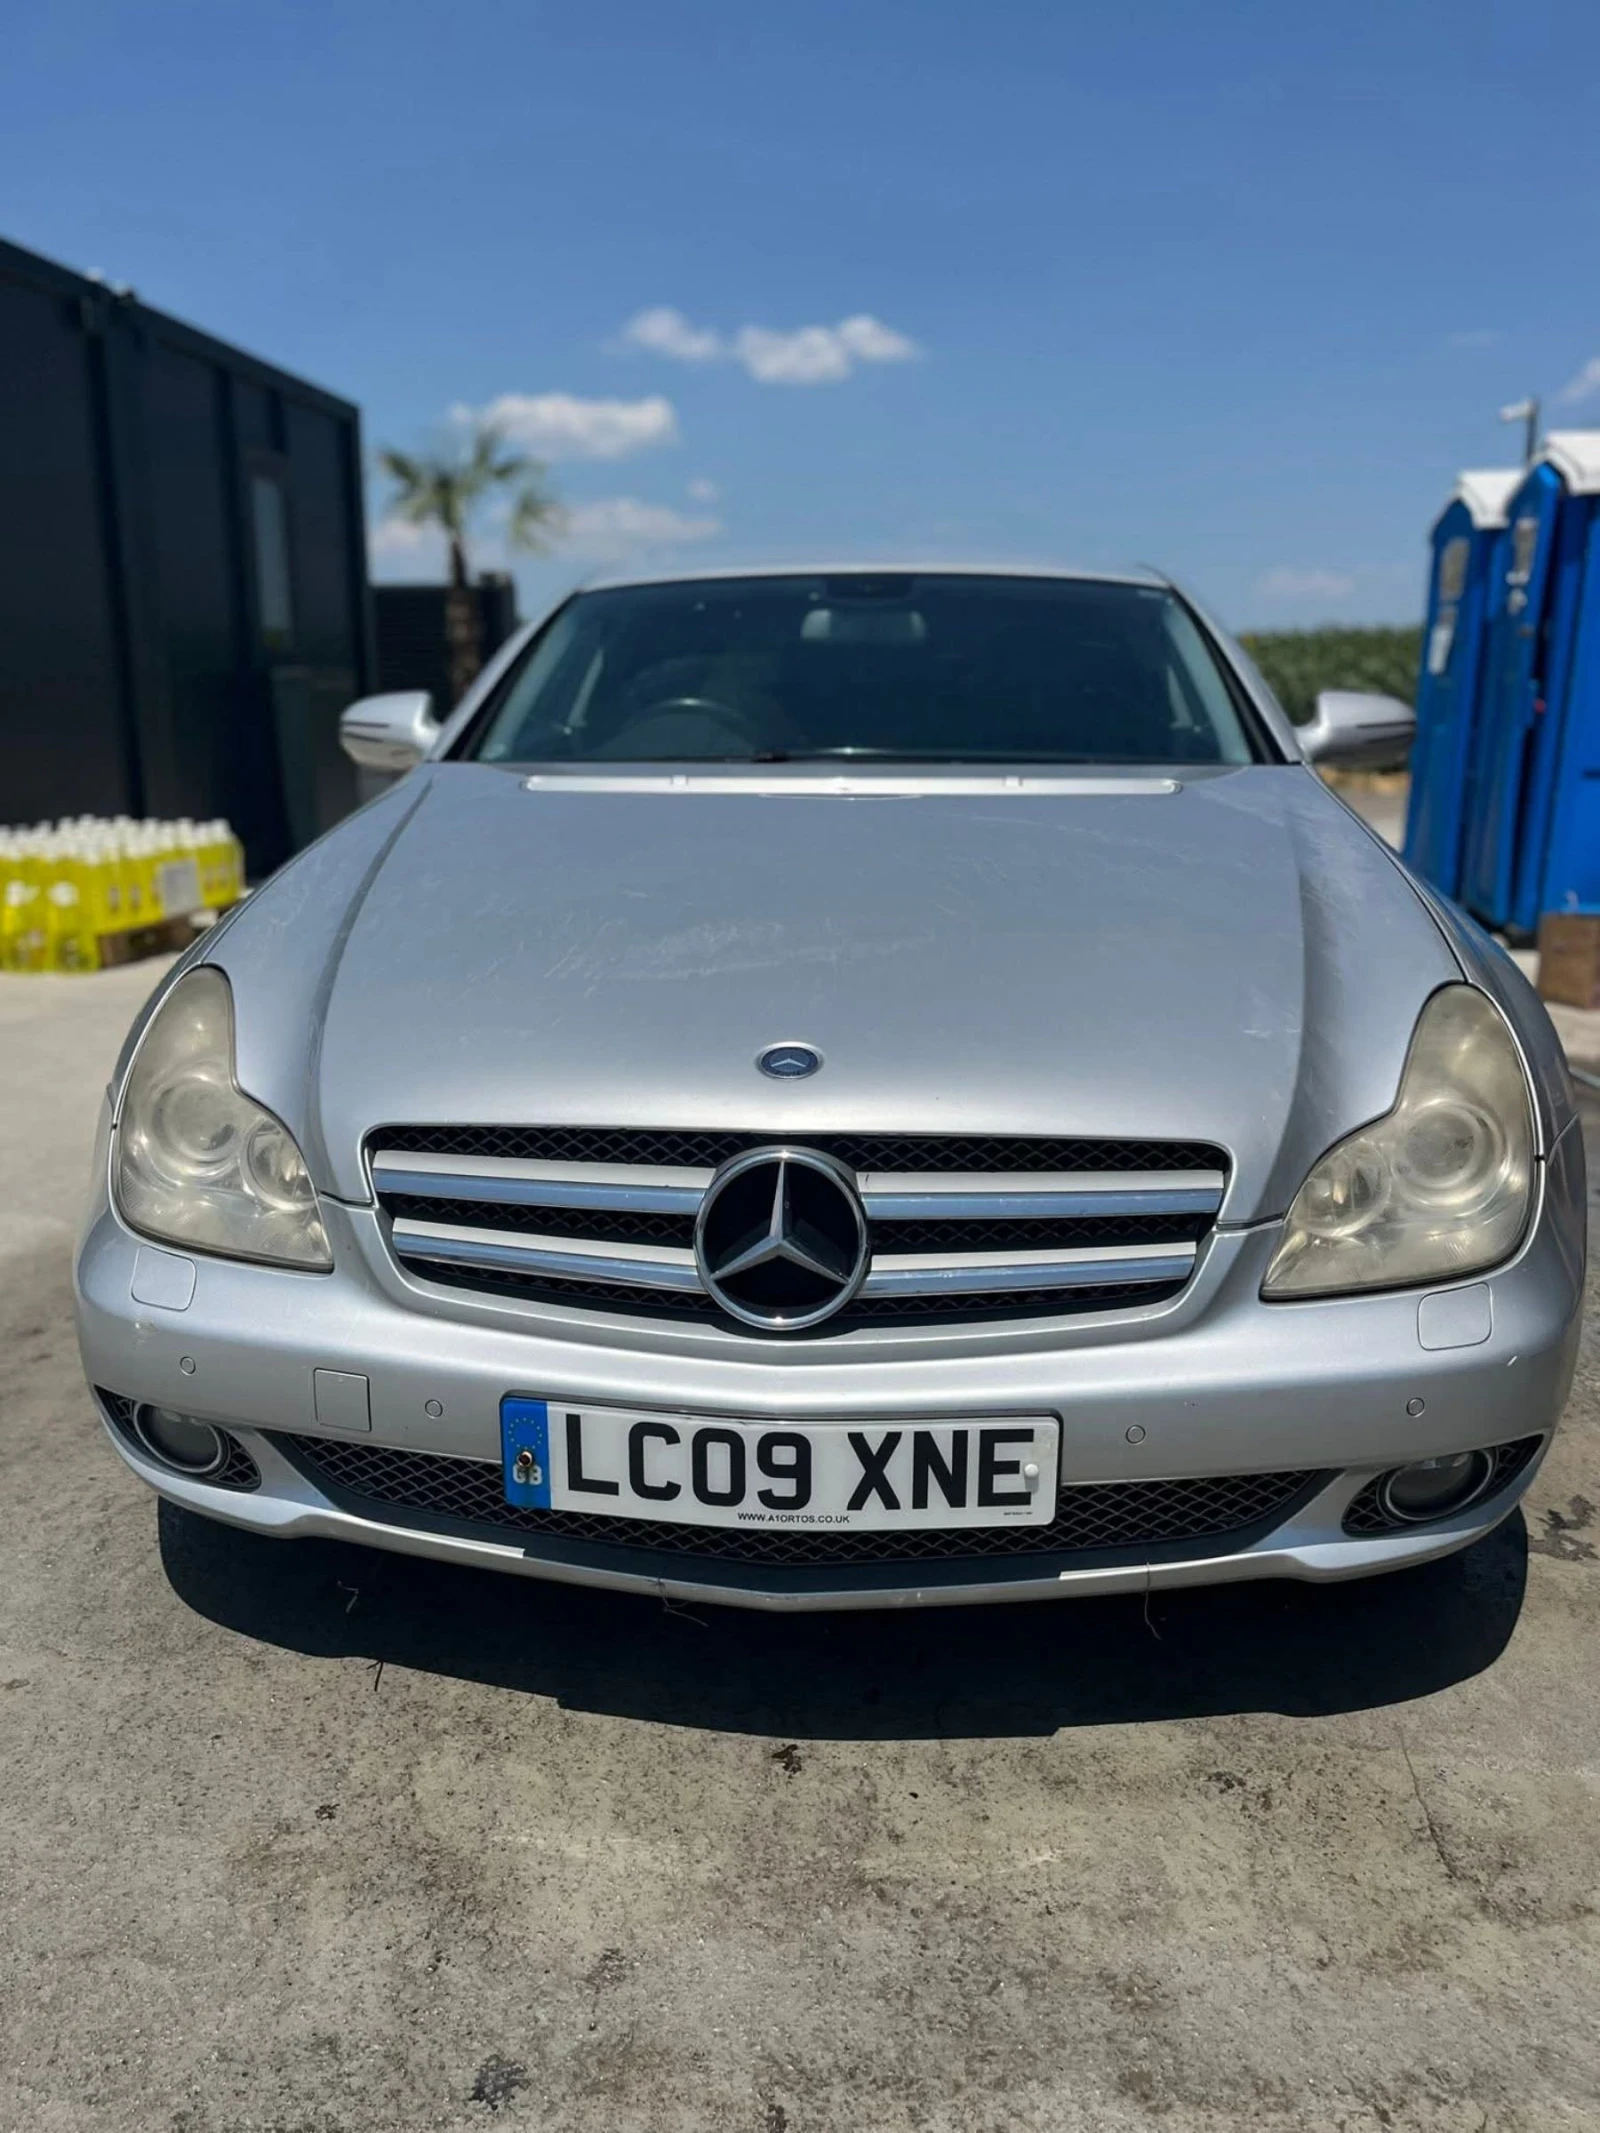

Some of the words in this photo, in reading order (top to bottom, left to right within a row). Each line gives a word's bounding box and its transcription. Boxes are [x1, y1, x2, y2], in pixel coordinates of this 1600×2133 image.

[512, 1463, 542, 1485] GB
[565, 1413, 812, 1510] LC09
[846, 1428, 1035, 1511] XNE
